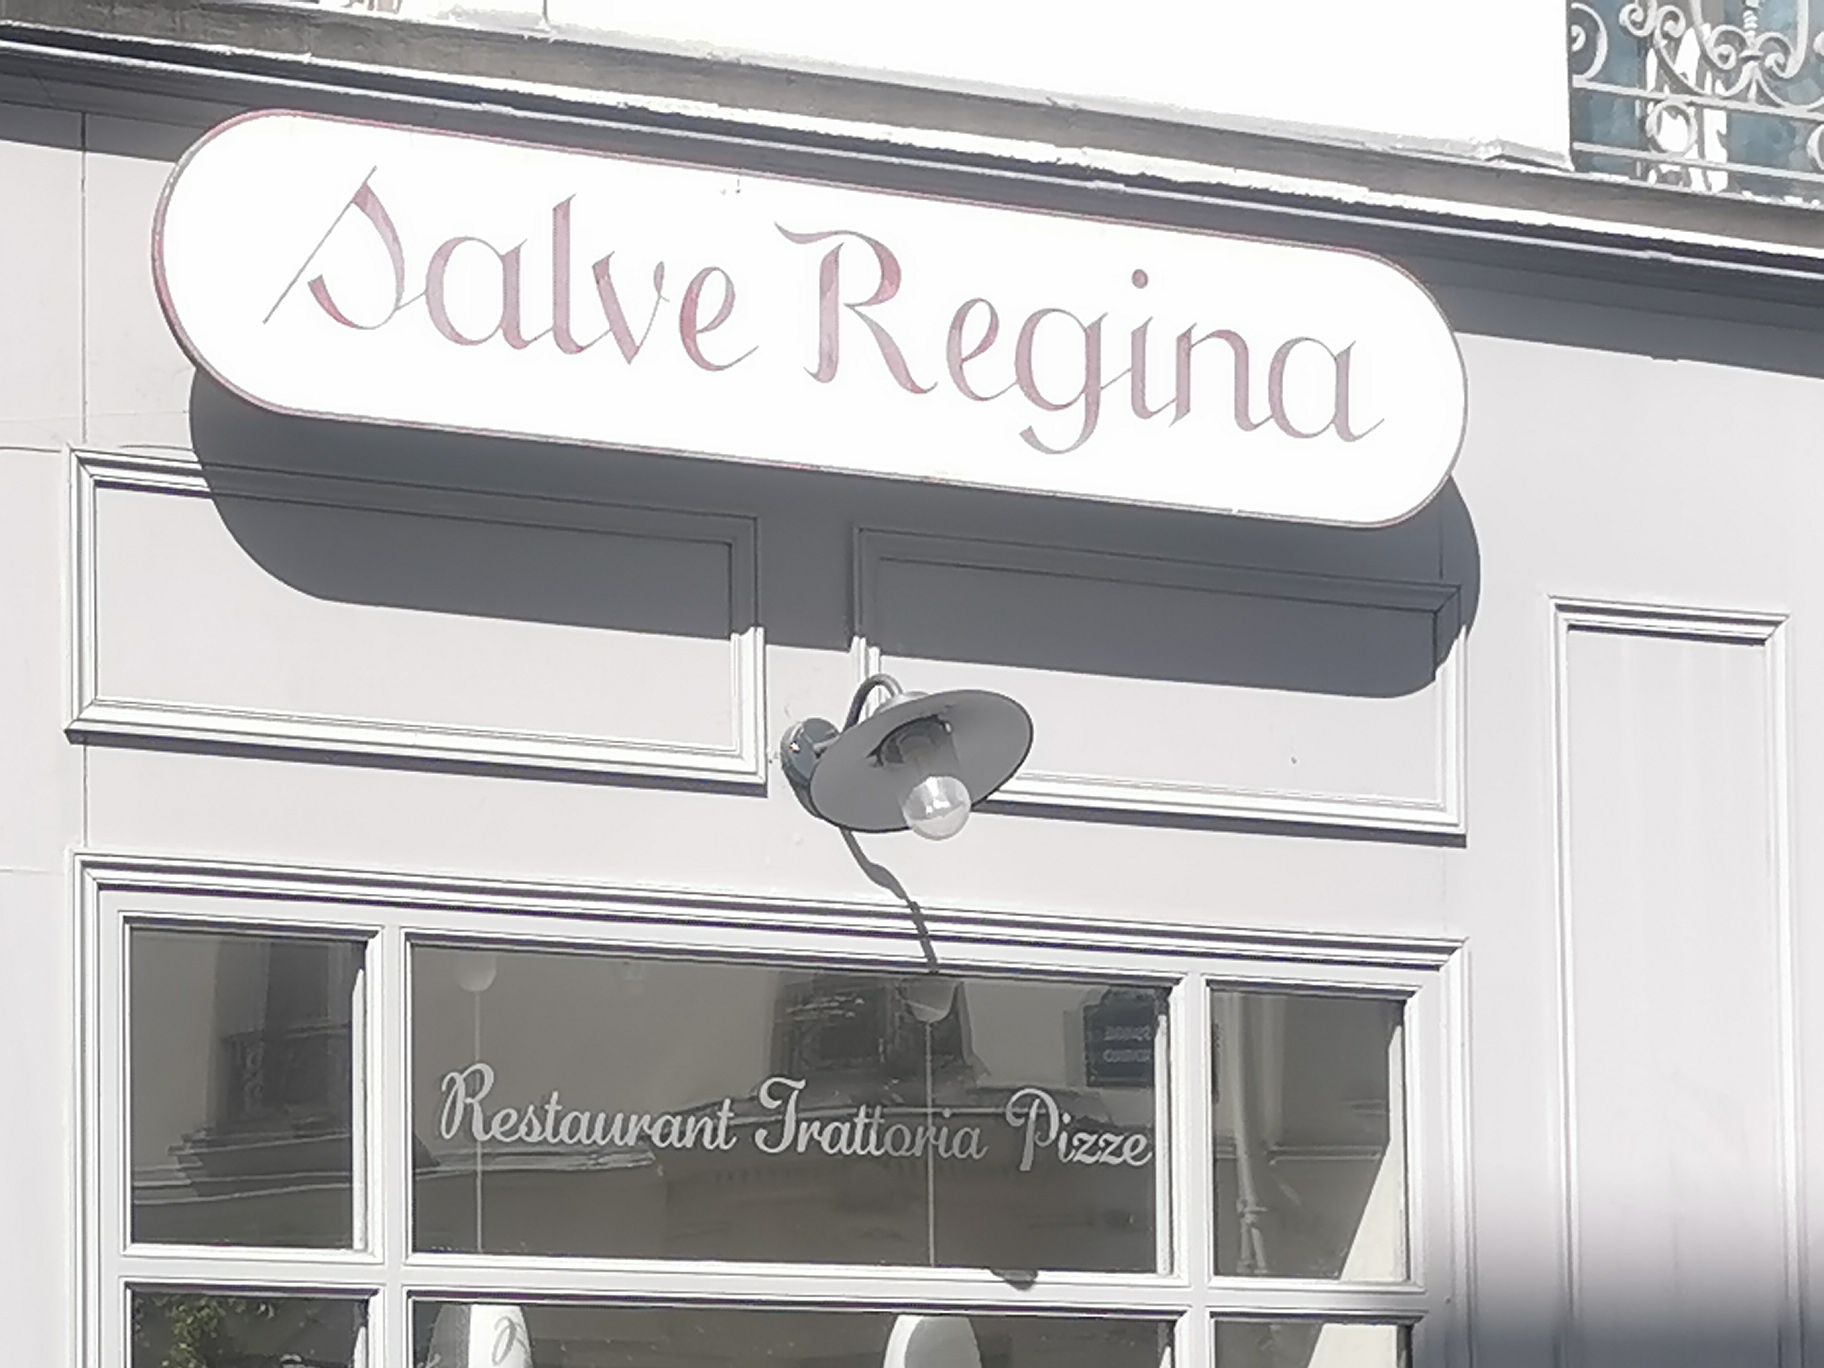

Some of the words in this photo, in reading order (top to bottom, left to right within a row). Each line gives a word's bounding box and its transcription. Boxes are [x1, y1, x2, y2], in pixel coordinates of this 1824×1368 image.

[262, 164, 759, 374] Salve
[774, 221, 1386, 455] Regina
[440, 1062, 737, 1150] Restaurant
[754, 1076, 988, 1160] Trattoria
